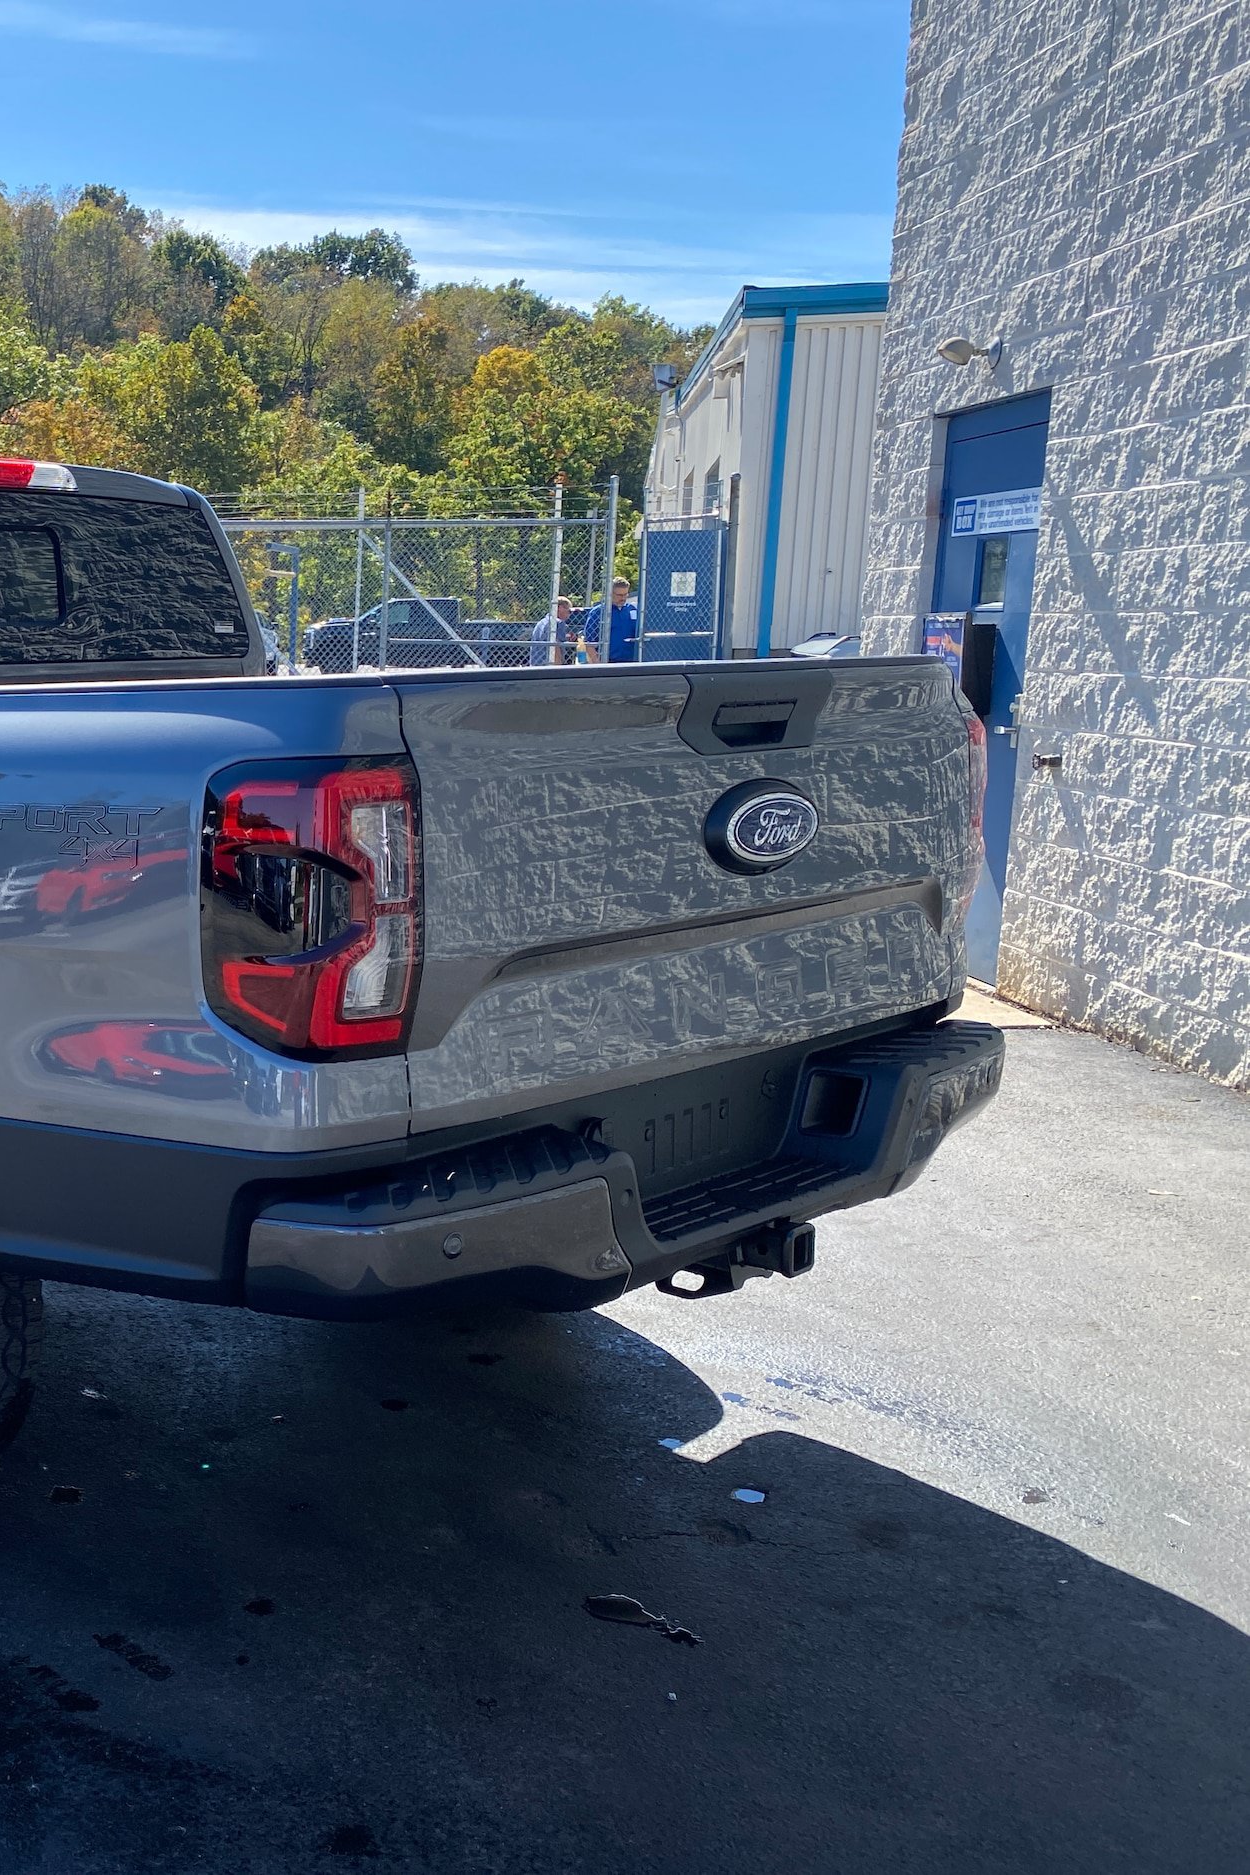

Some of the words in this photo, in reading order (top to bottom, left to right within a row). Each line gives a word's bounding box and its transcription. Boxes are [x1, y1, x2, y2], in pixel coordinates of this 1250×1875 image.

[1004, 494, 1031, 507] responsible
[1031, 492, 1039, 502] for
[956, 515, 973, 529] BOX
[753, 807, 802, 847] Ford
